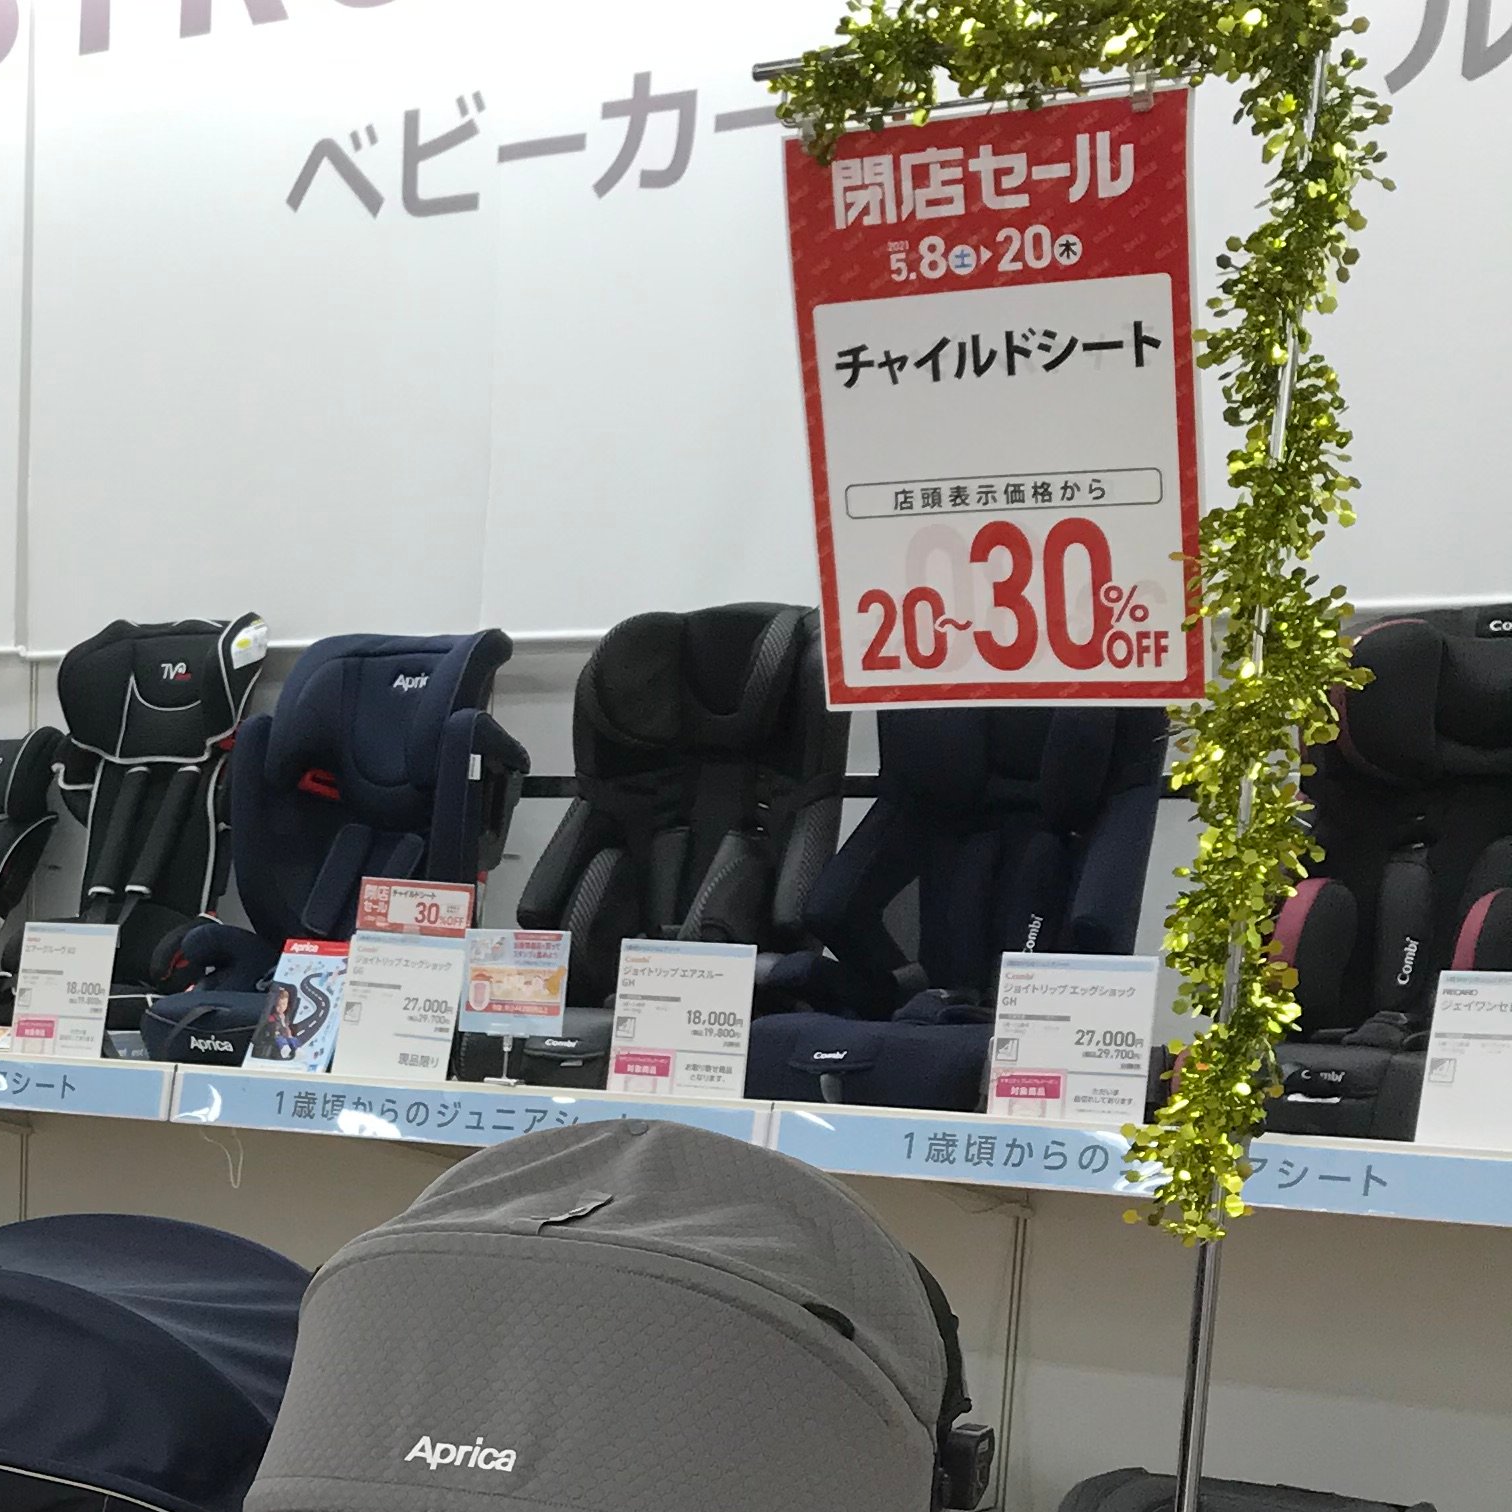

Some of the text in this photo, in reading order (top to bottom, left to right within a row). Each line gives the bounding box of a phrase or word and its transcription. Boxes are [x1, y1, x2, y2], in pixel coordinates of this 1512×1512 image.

[831, 131, 1135, 230] 閉店セール
[834, 320, 1162, 389] チャイルドシート
[893, 477, 1107, 512] 店頭表示価格から
[289, 941, 319, 954] Aprica
[1397, 936, 1420, 987] Combi
[623, 965, 724, 979] ジョイトリップ エアスルー
[1003, 982, 1137, 1000] ジョイトリップ エッグショック
[402, 997, 454, 1014] 27,000円
[685, 1008, 744, 1027] 18,000円
[189, 1033, 234, 1054] Aprica
[544, 1037, 579, 1049] Combi
[1074, 1029, 1145, 1050] 27,000円
[813, 1050, 848, 1061] Combi
[1300, 1067, 1346, 1083] Cmbi
[275, 1090, 626, 1133] 1歳頃からのジュニアシ
[404, 1436, 518, 1473] Aprica
